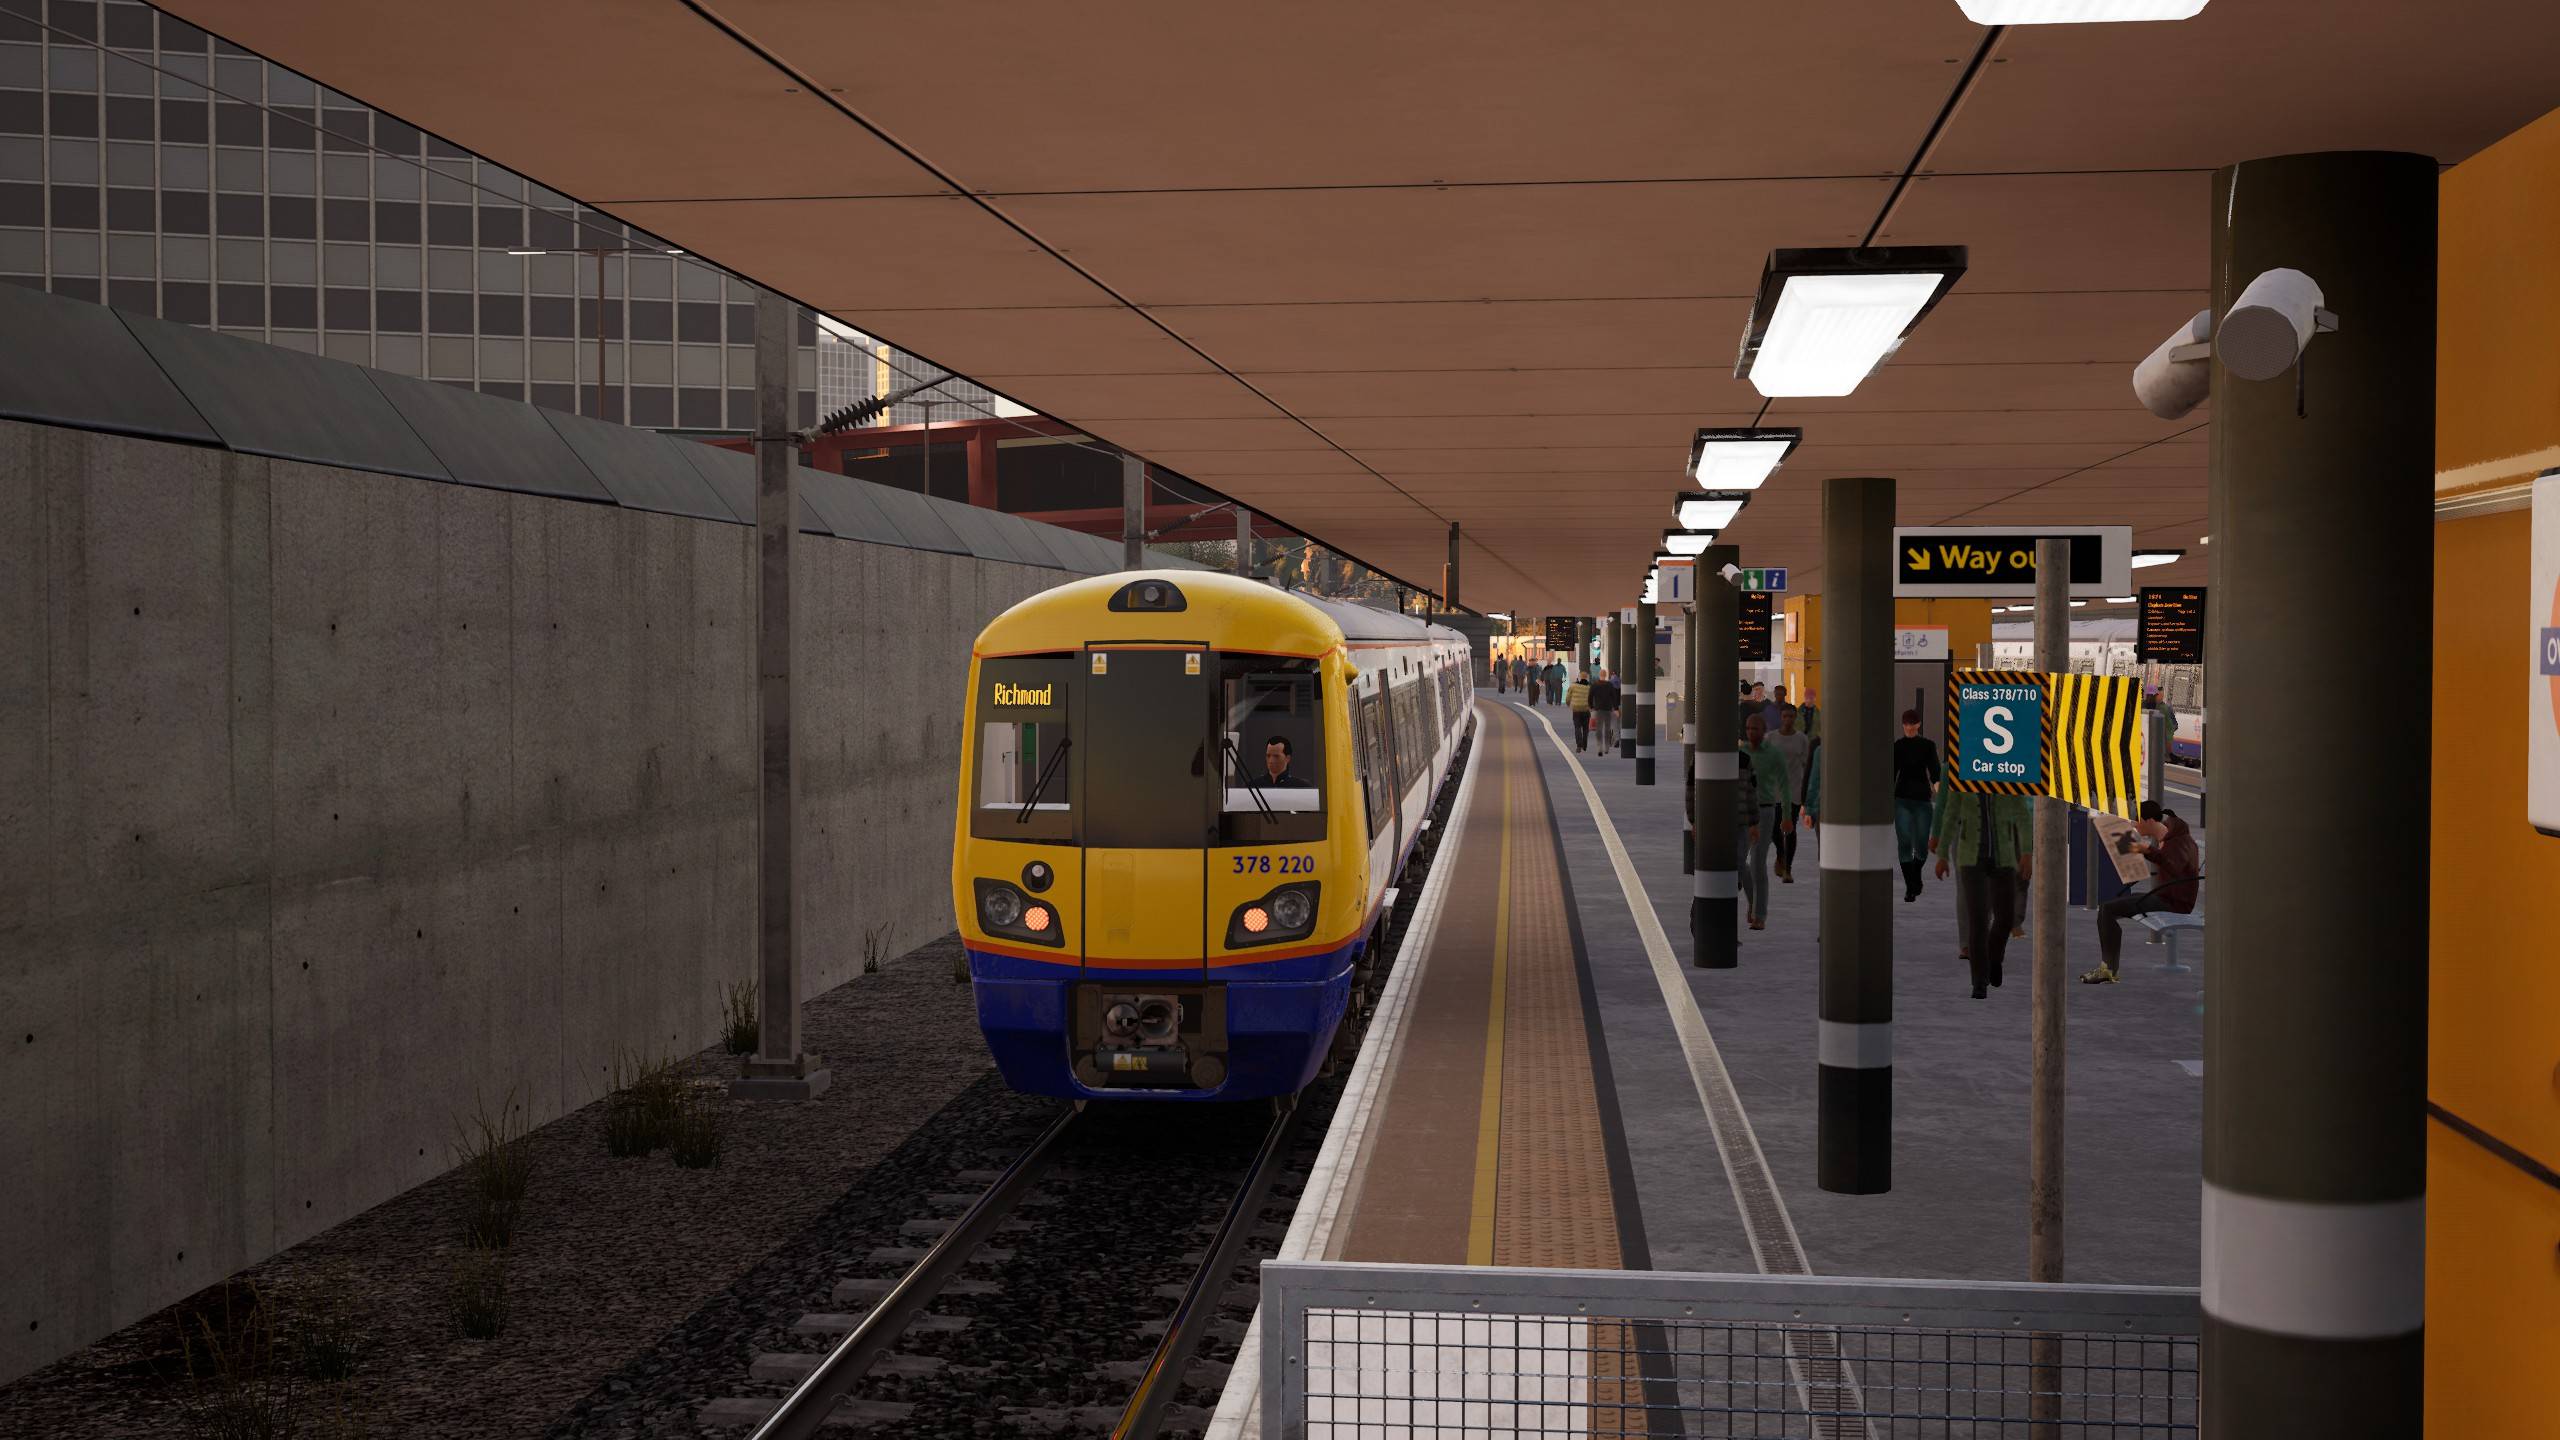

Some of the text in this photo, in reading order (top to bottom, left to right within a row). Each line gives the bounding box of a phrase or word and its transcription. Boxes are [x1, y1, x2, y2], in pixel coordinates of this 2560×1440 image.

[1938, 544, 2002, 575] Way
[994, 682, 1052, 706] Richmond
[1962, 687, 2037, 701] Class 378/710
[1982, 705, 2014, 755] S
[1972, 759, 2026, 777] Car stop
[1232, 855, 1315, 874] 378 220
